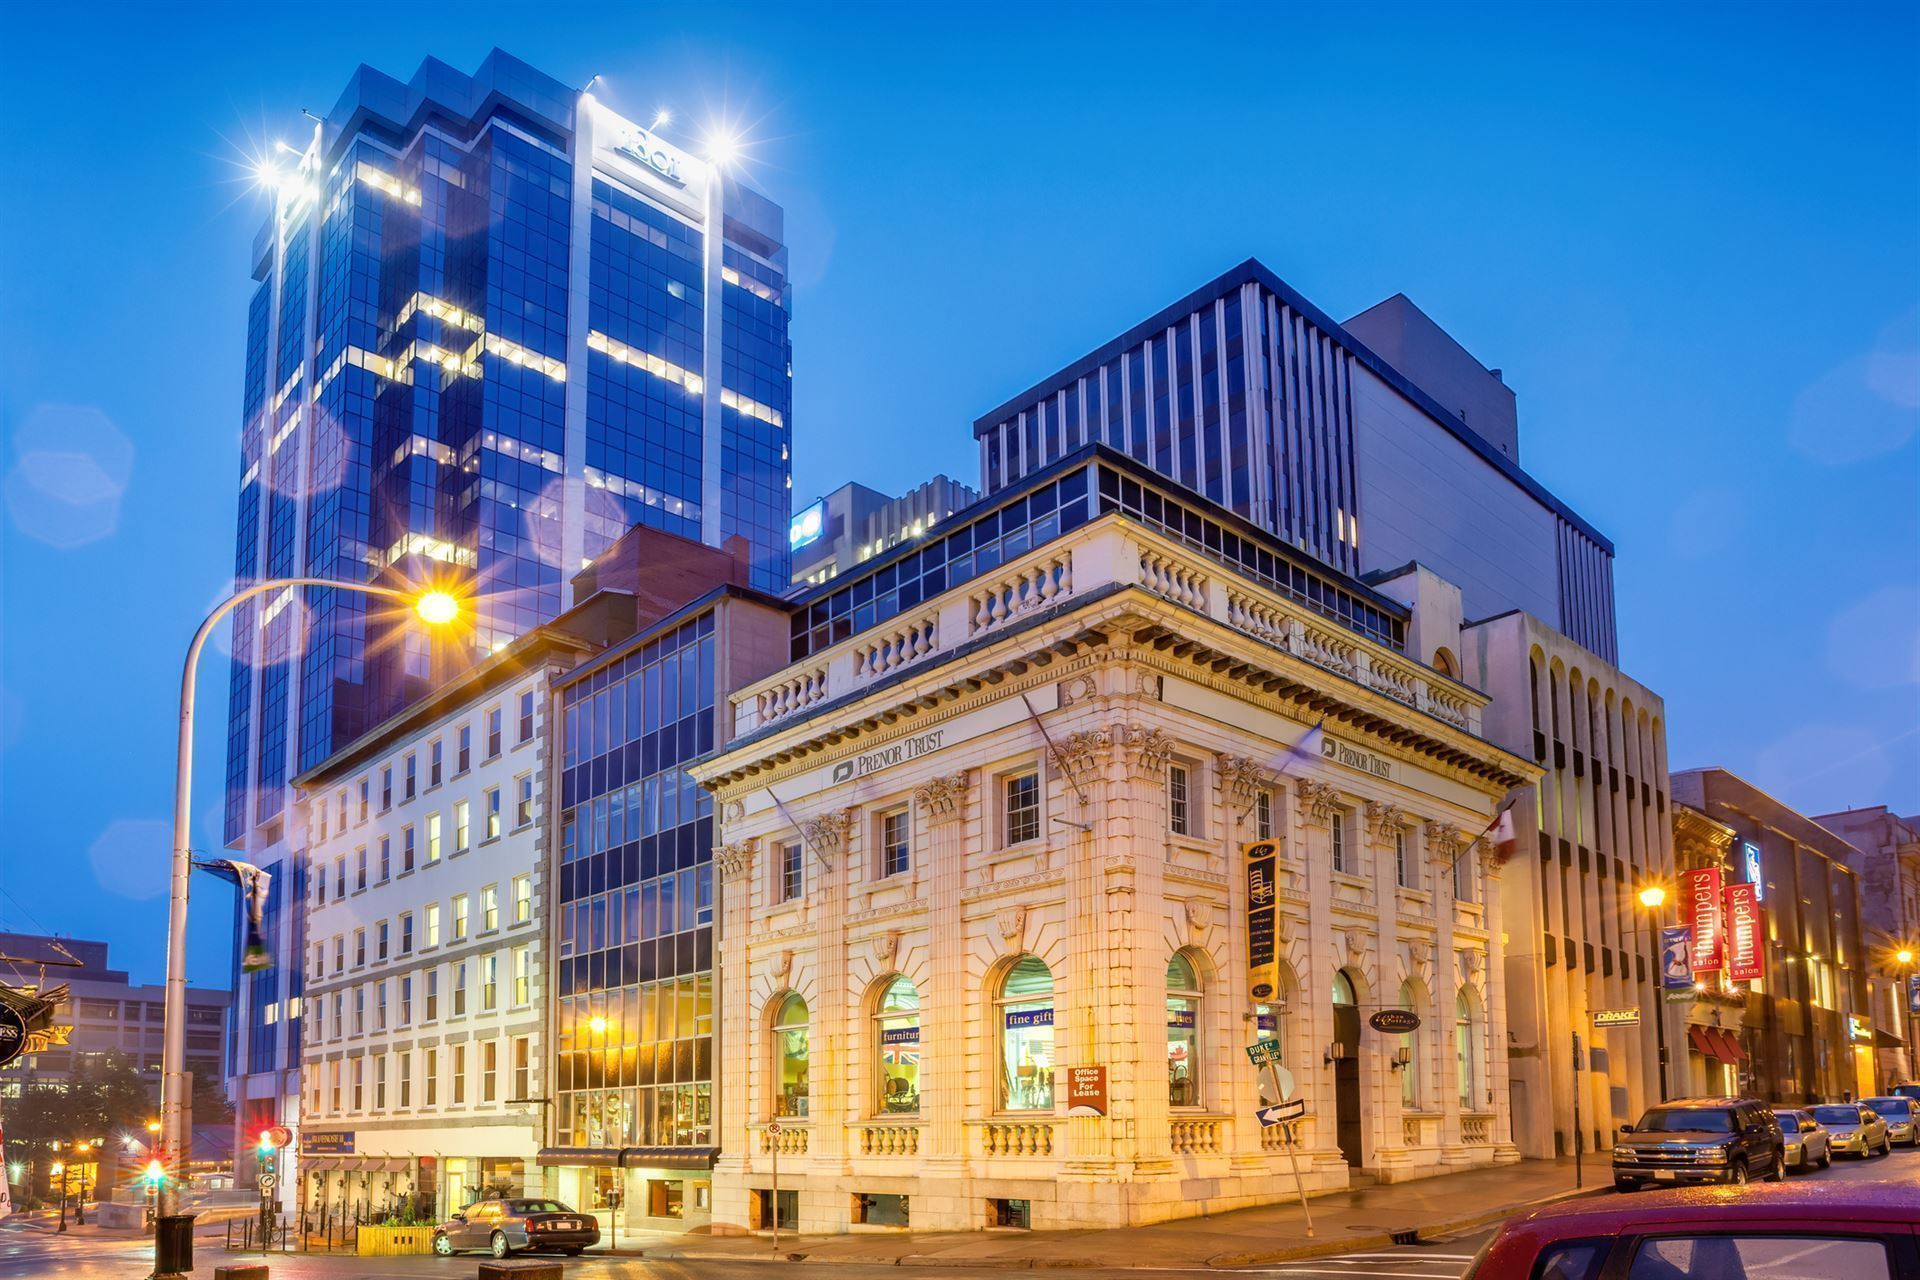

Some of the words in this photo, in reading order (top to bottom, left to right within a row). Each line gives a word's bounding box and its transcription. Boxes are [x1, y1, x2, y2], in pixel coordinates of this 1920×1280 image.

[857, 745, 903, 776] PRENOR
[904, 729, 944, 758] TRUST
[1338, 742, 1368, 772] PRENOR
[1369, 753, 1392, 779] TRUST
[1692, 872, 1718, 958] thumpers
[1733, 888, 1756, 967] thumpers
[1692, 957, 1719, 967] salon
[1734, 967, 1759, 976] salon
[1009, 1015, 1030, 1025] fine
[1597, 1011, 1636, 1021] DRAKE
[1249, 1043, 1270, 1055] DUKE
[1074, 1068, 1099, 1076] Office
[1074, 1075, 1099, 1083] Space
